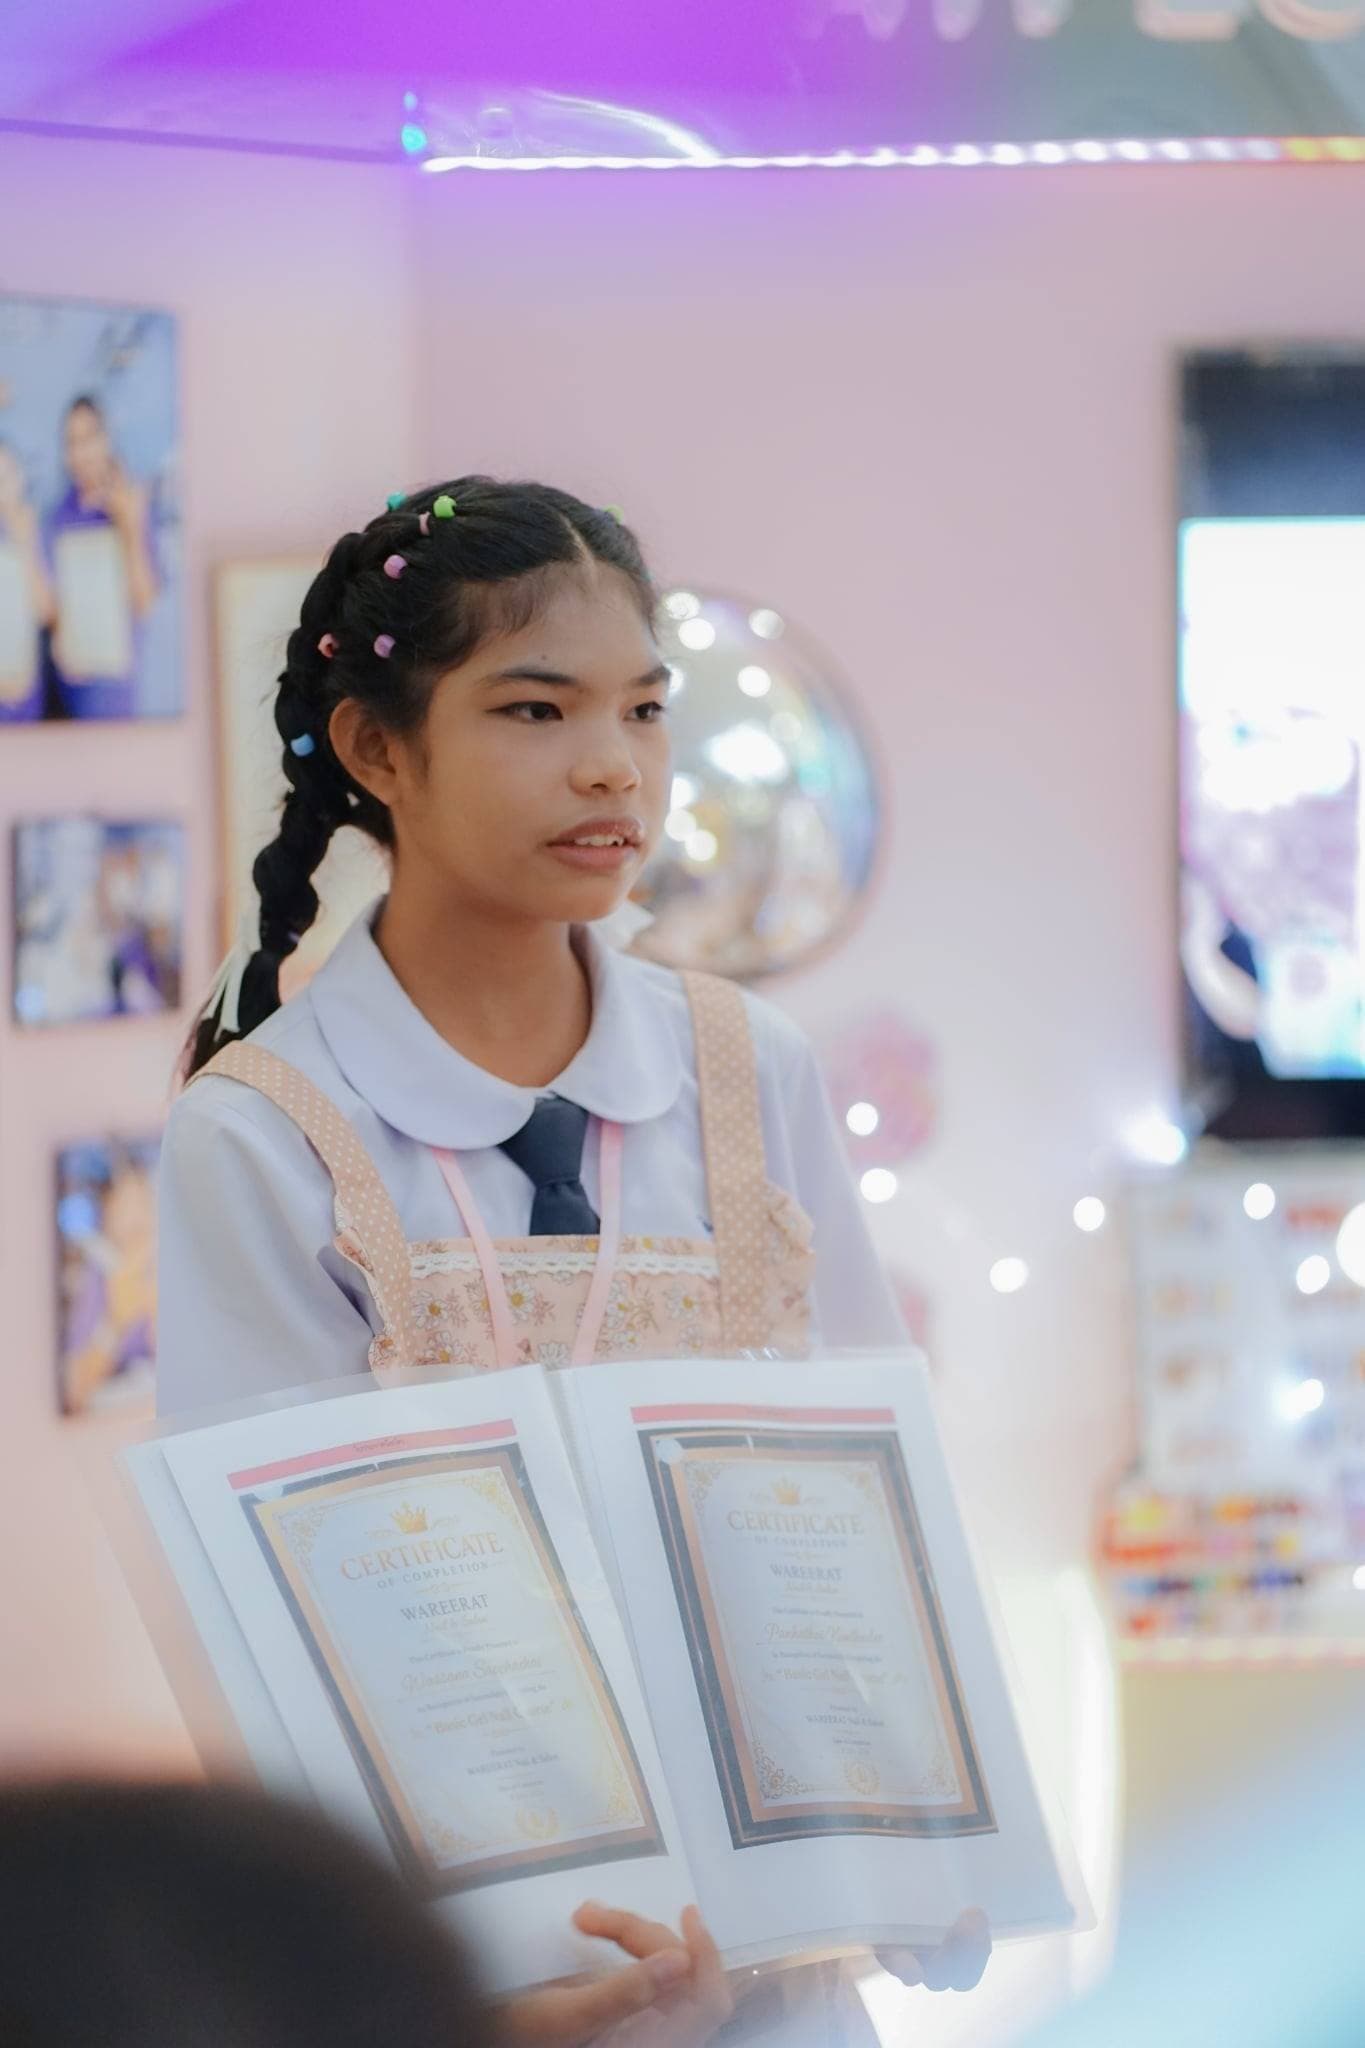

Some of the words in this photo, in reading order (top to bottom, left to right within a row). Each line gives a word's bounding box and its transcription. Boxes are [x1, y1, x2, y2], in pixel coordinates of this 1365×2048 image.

[726, 1510, 865, 1535] CERTIFICATE
[340, 1531, 504, 1581] CERTIFICATE
[402, 1562, 489, 1583] COMPLETION
[399, 1593, 489, 1622] WAREERAT
